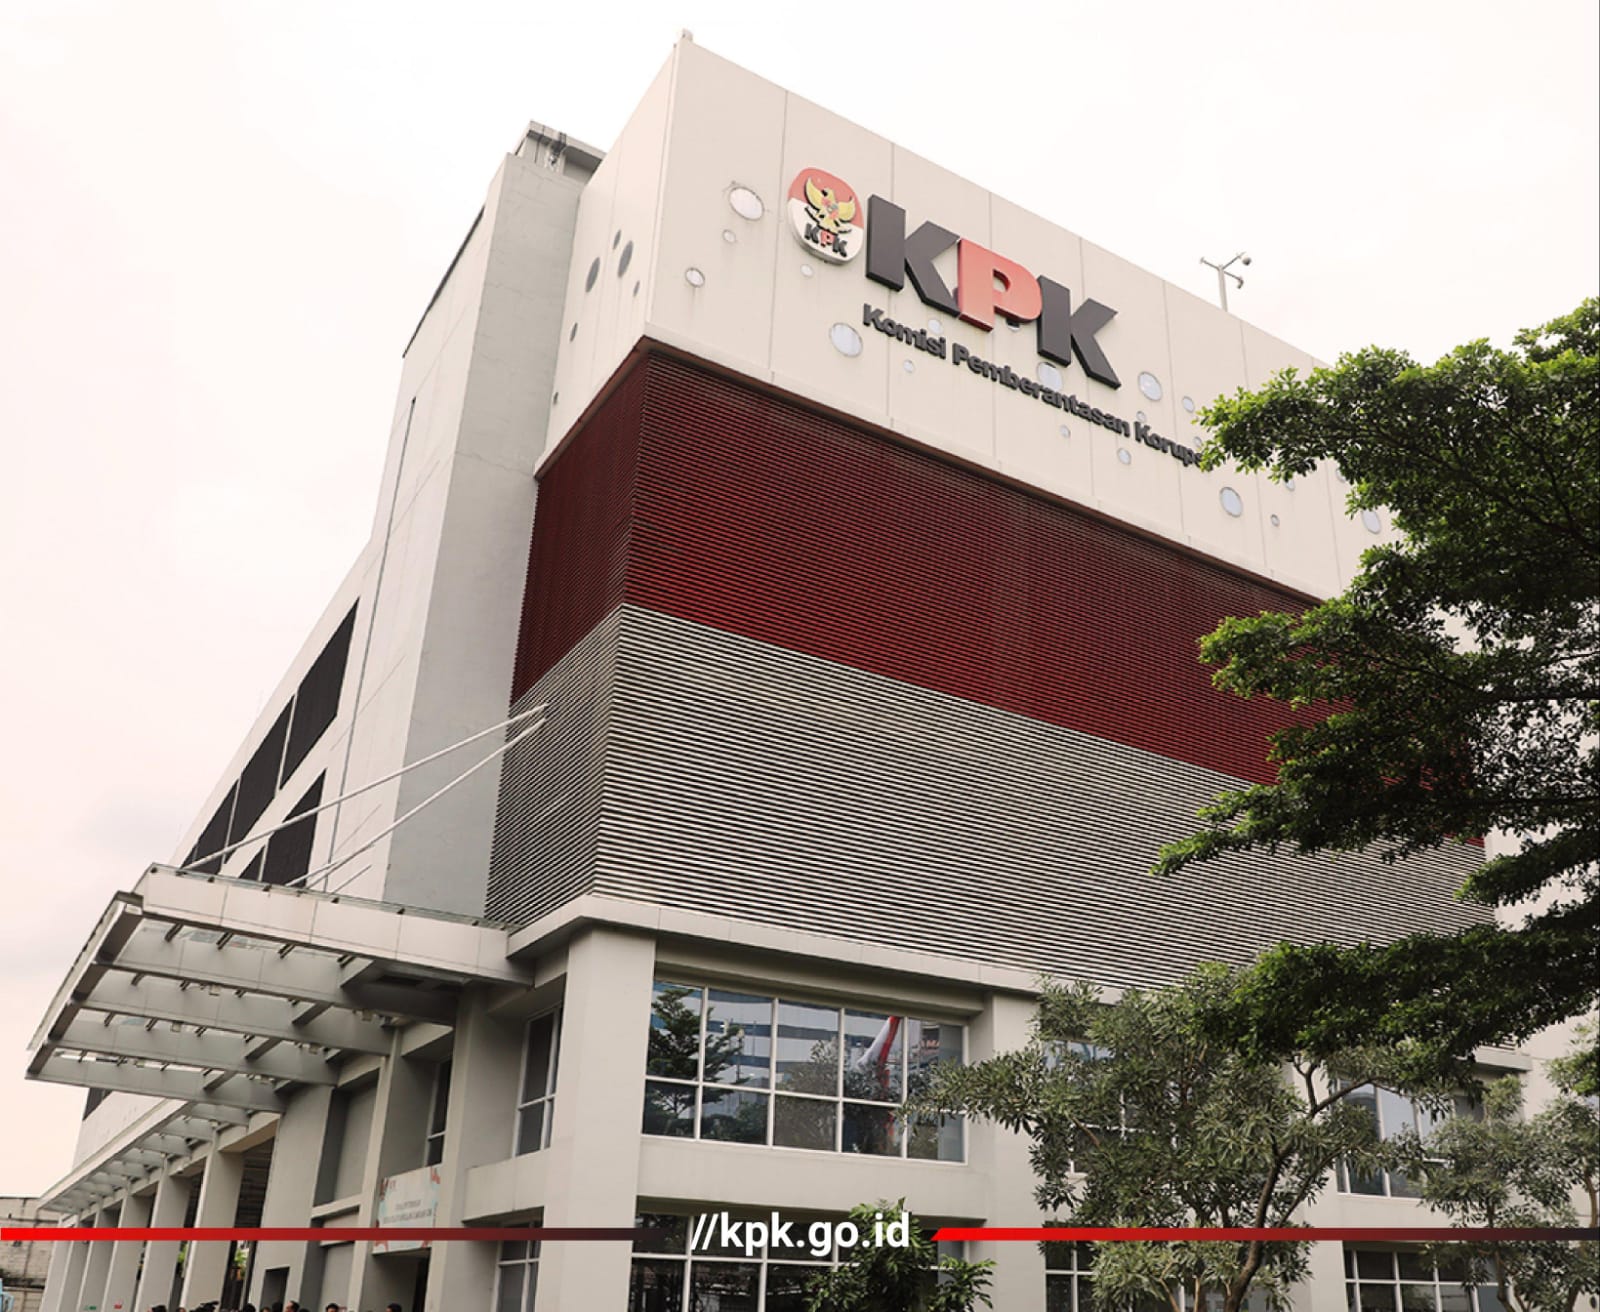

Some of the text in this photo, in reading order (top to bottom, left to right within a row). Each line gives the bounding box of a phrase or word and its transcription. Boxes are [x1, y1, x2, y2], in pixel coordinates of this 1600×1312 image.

[804, 223, 847, 257] KPK
[866, 194, 1121, 389] KPK
[863, 303, 946, 360] Komisi
[952, 342, 1130, 438] Pemberantasan
